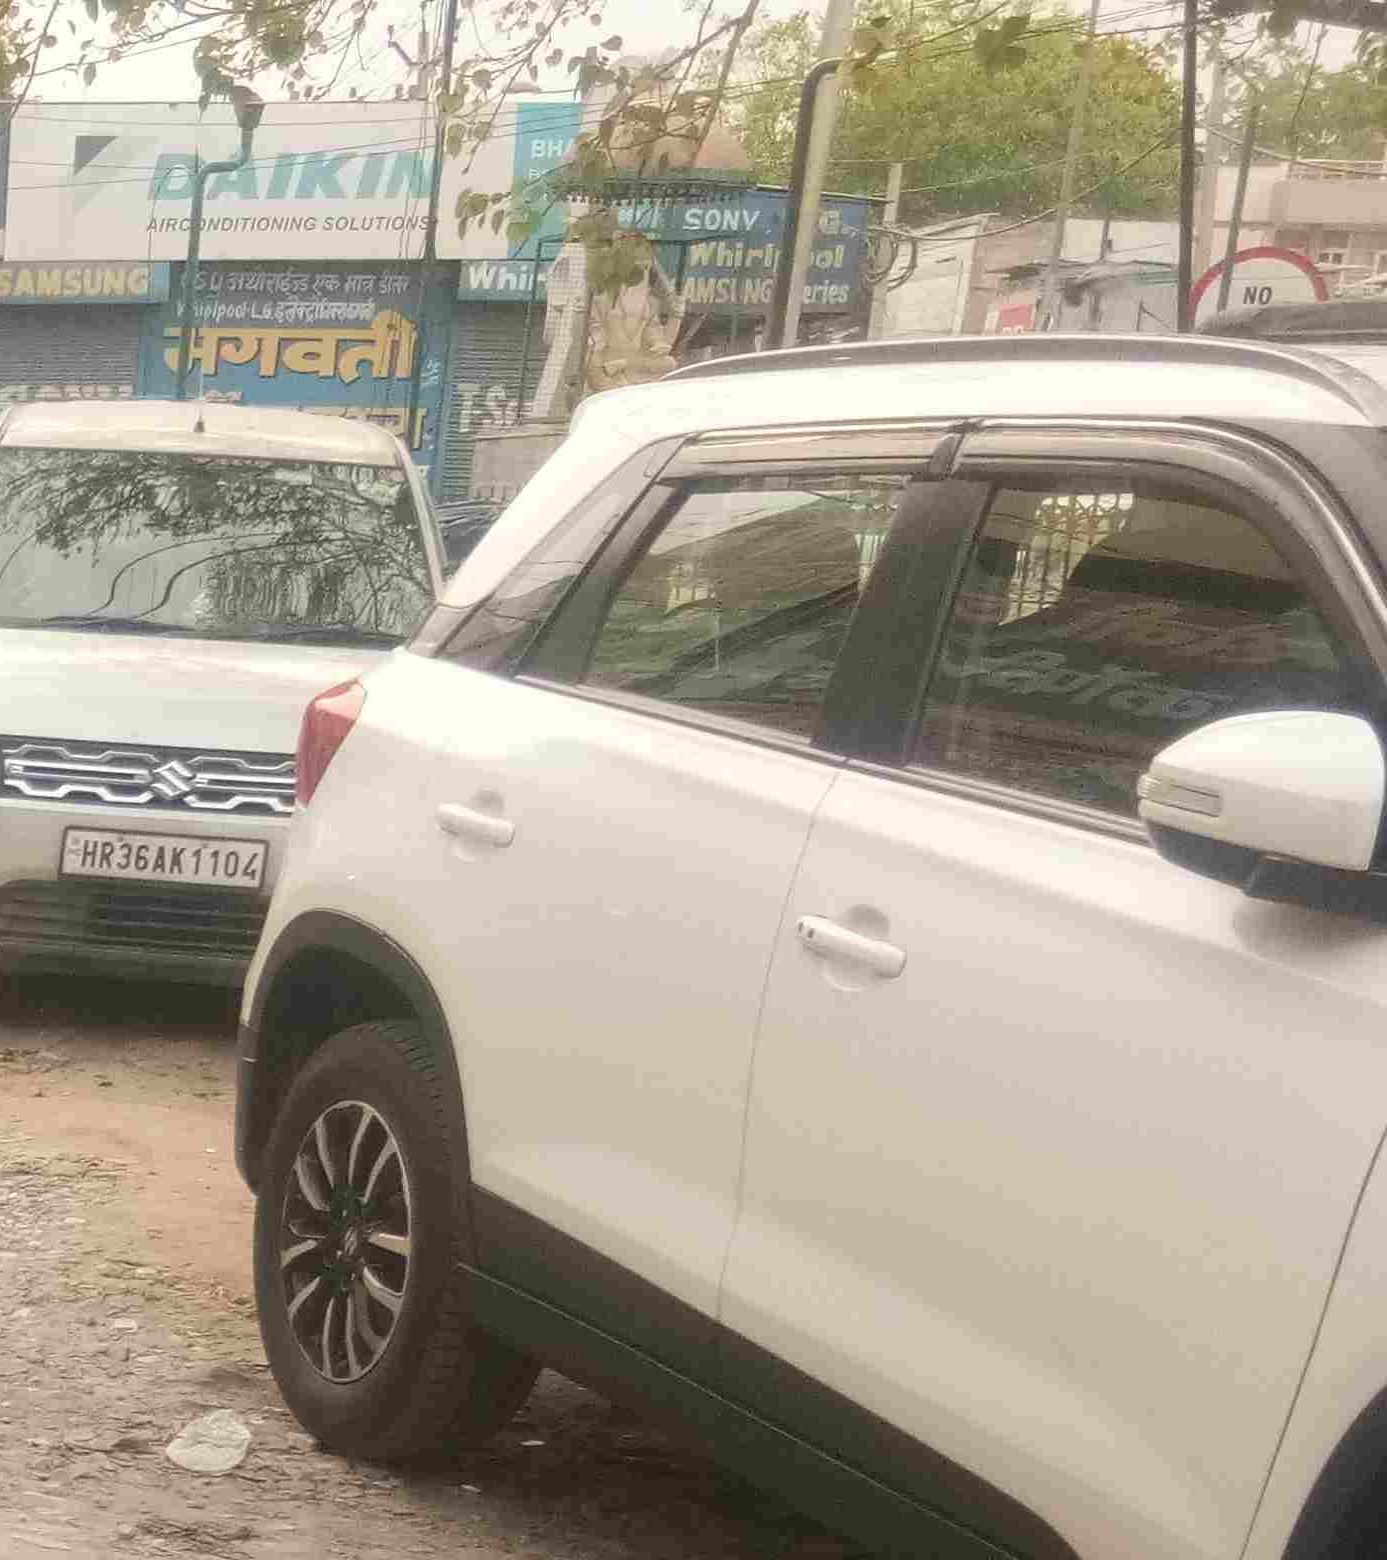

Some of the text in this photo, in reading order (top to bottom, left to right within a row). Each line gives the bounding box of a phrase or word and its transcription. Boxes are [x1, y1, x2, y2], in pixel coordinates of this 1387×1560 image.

[149, 152, 437, 201] DAIKIN
[323, 214, 428, 232] SOLUTIONS
[676, 278, 774, 304] AMSUNG
[1243, 285, 1273, 305] NO
[80, 840, 258, 879] HR36AK1104
